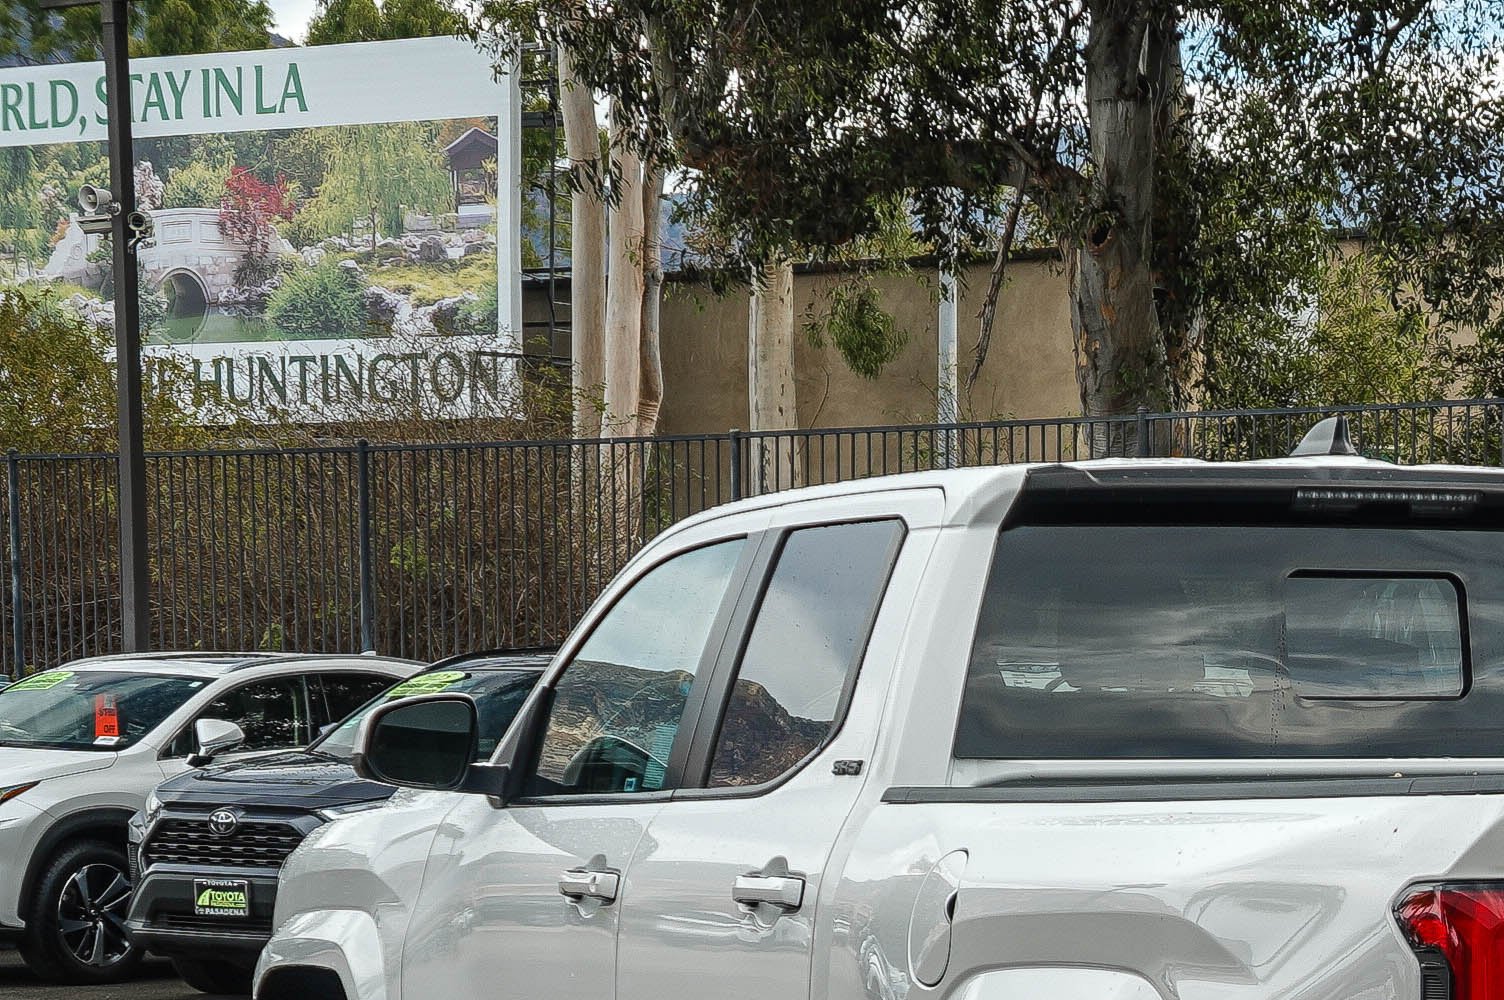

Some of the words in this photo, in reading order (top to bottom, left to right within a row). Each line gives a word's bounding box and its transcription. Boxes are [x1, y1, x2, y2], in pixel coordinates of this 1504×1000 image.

[200, 66, 243, 118] IN
[254, 62, 309, 115] LA
[210, 890, 245, 902] TOYOTA
